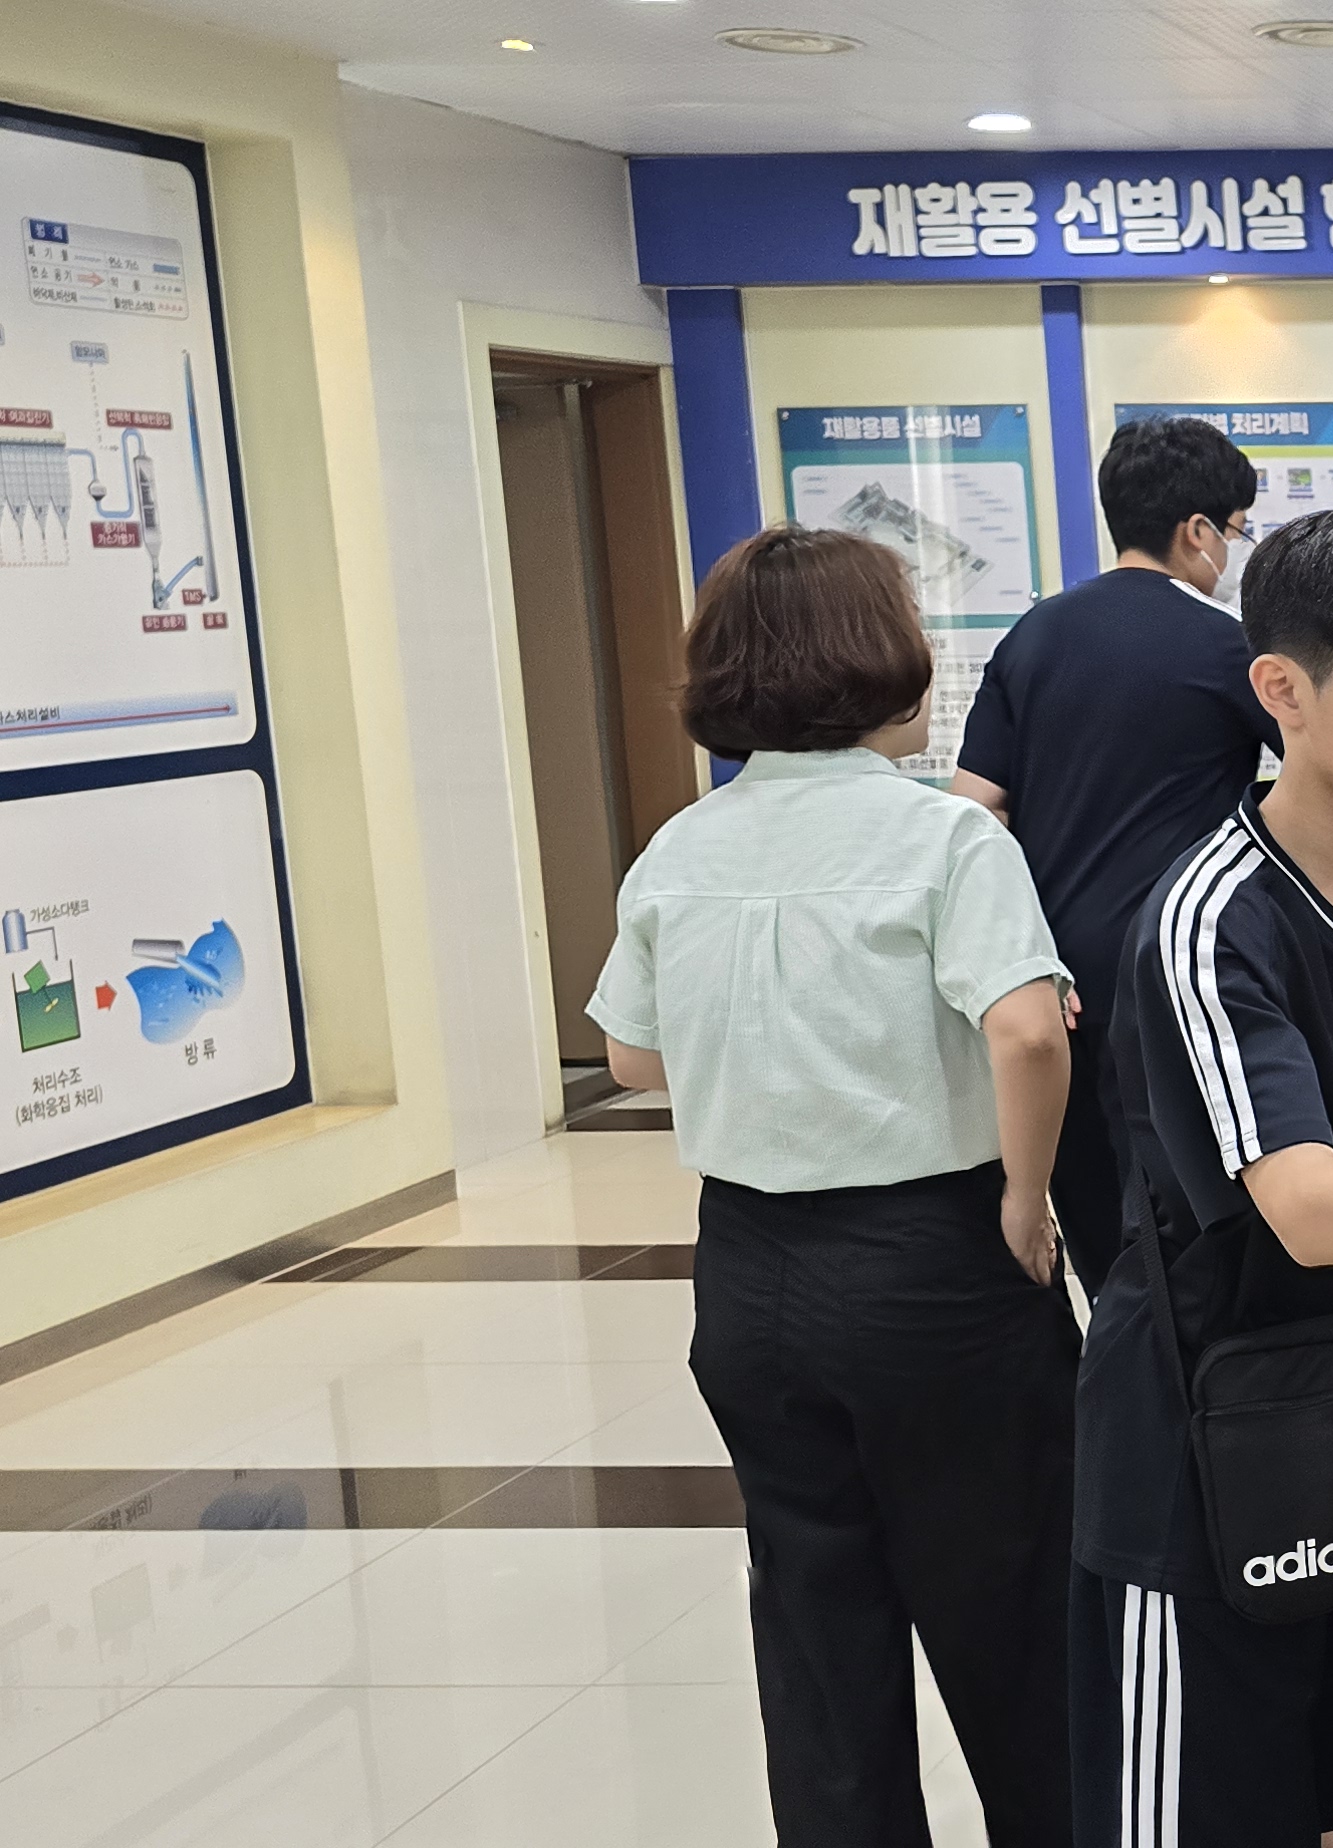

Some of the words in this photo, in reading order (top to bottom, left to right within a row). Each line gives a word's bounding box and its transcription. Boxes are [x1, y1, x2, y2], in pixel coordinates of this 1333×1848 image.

[849, 180, 1037, 257] 재활용
[1054, 175, 1307, 253] 선별시설
[1232, 412, 1309, 435] 처리계획
[0, 706, 60, 725] 스처리설비
[30, 899, 90, 922] 가성소다탱크
[33, 1067, 82, 1095] 처리수조
[74, 1084, 103, 1108] 처리)
